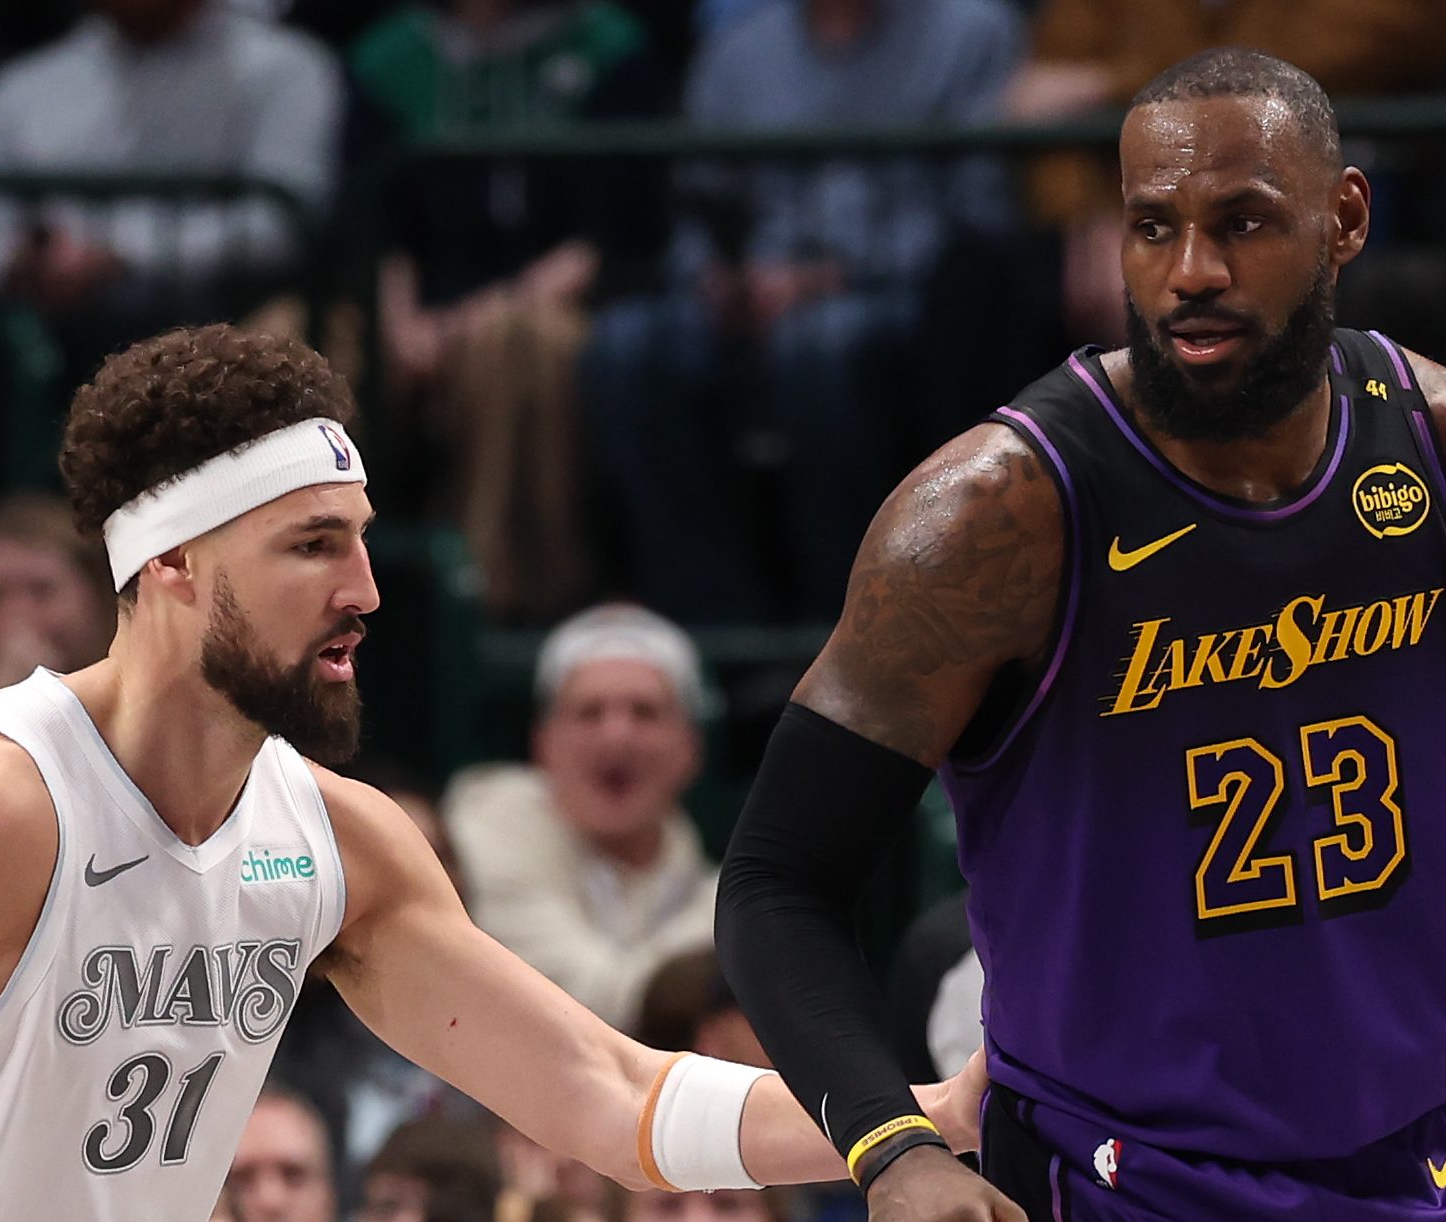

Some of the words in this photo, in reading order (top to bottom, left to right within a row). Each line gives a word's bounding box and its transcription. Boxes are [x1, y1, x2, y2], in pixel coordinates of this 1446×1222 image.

[1365, 379, 1388, 400] 44
[1358, 482, 1423, 513] bibigo
[1185, 714, 1408, 922] 23
[240, 850, 315, 882] chime
[58, 938, 302, 1046] MAVS
[82, 1051, 226, 1176] 31
[862, 1118, 912, 1147] PROMISE
